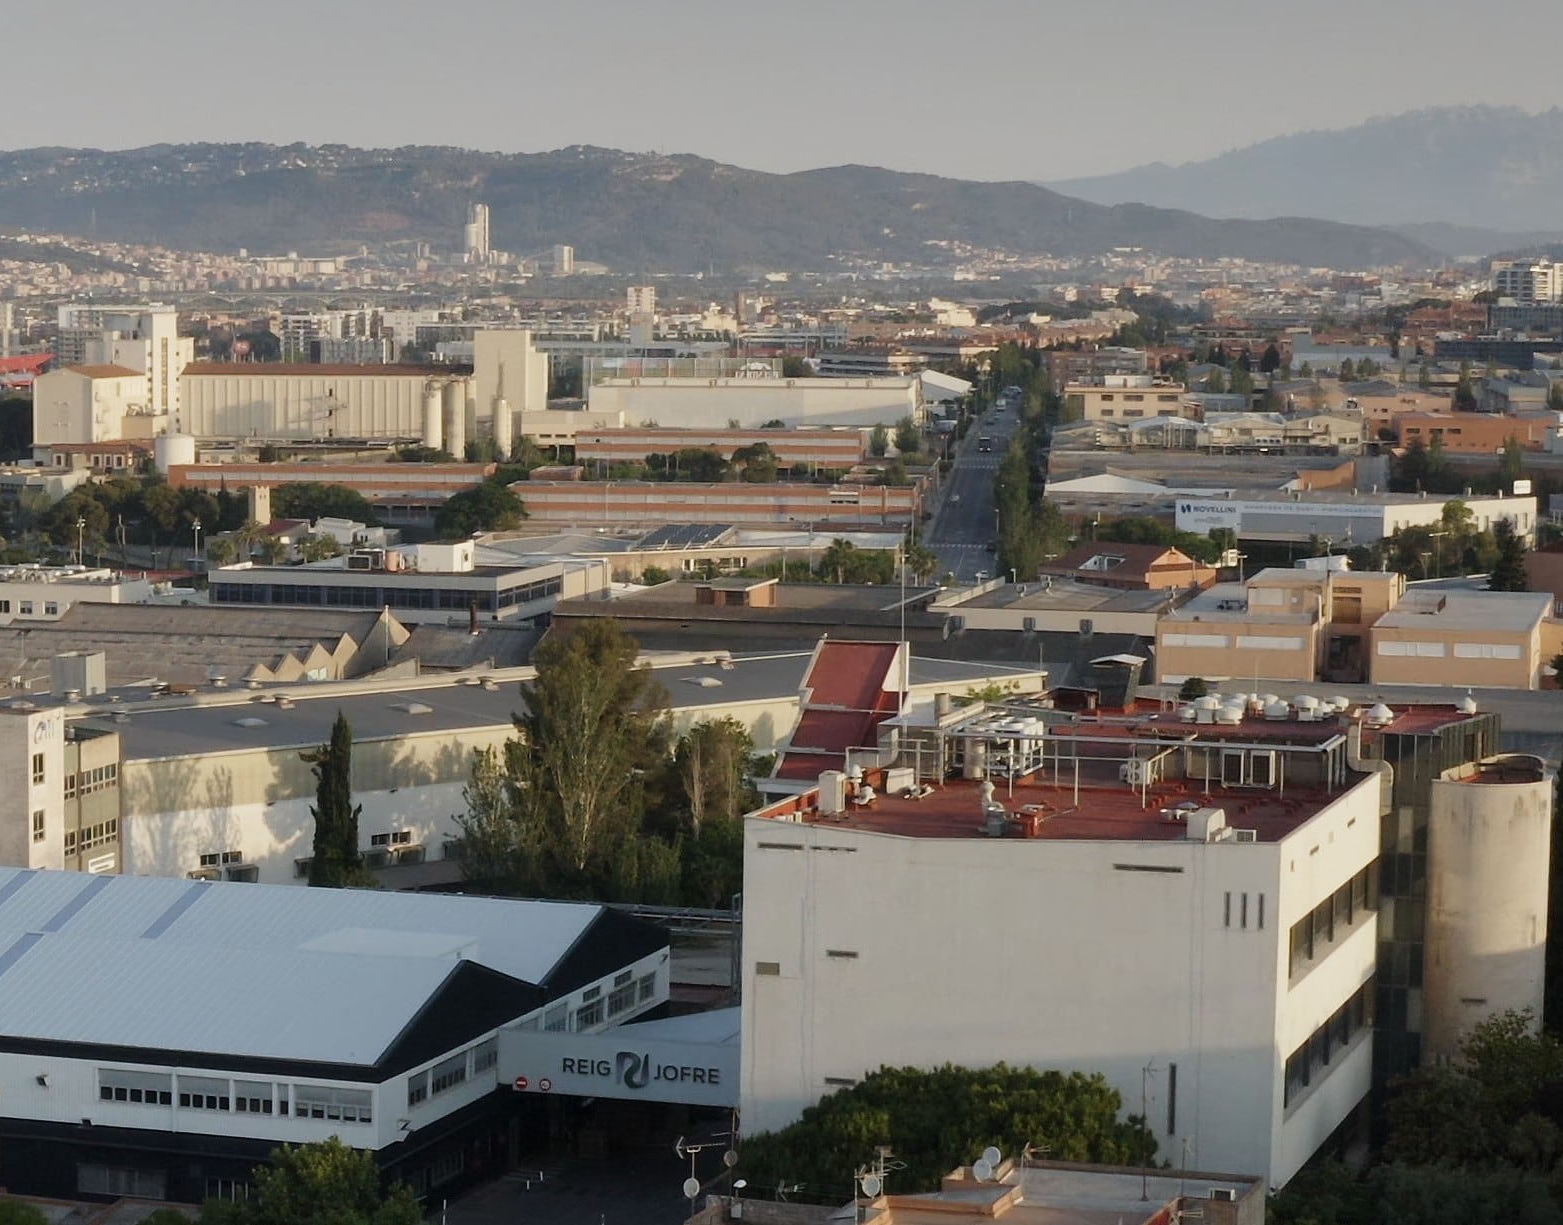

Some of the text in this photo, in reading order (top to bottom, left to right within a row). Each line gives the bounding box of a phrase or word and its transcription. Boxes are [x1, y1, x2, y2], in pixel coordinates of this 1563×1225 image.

[1193, 505, 1236, 513] NOVELLINI
[562, 1057, 720, 1085] REIG JOFRE
